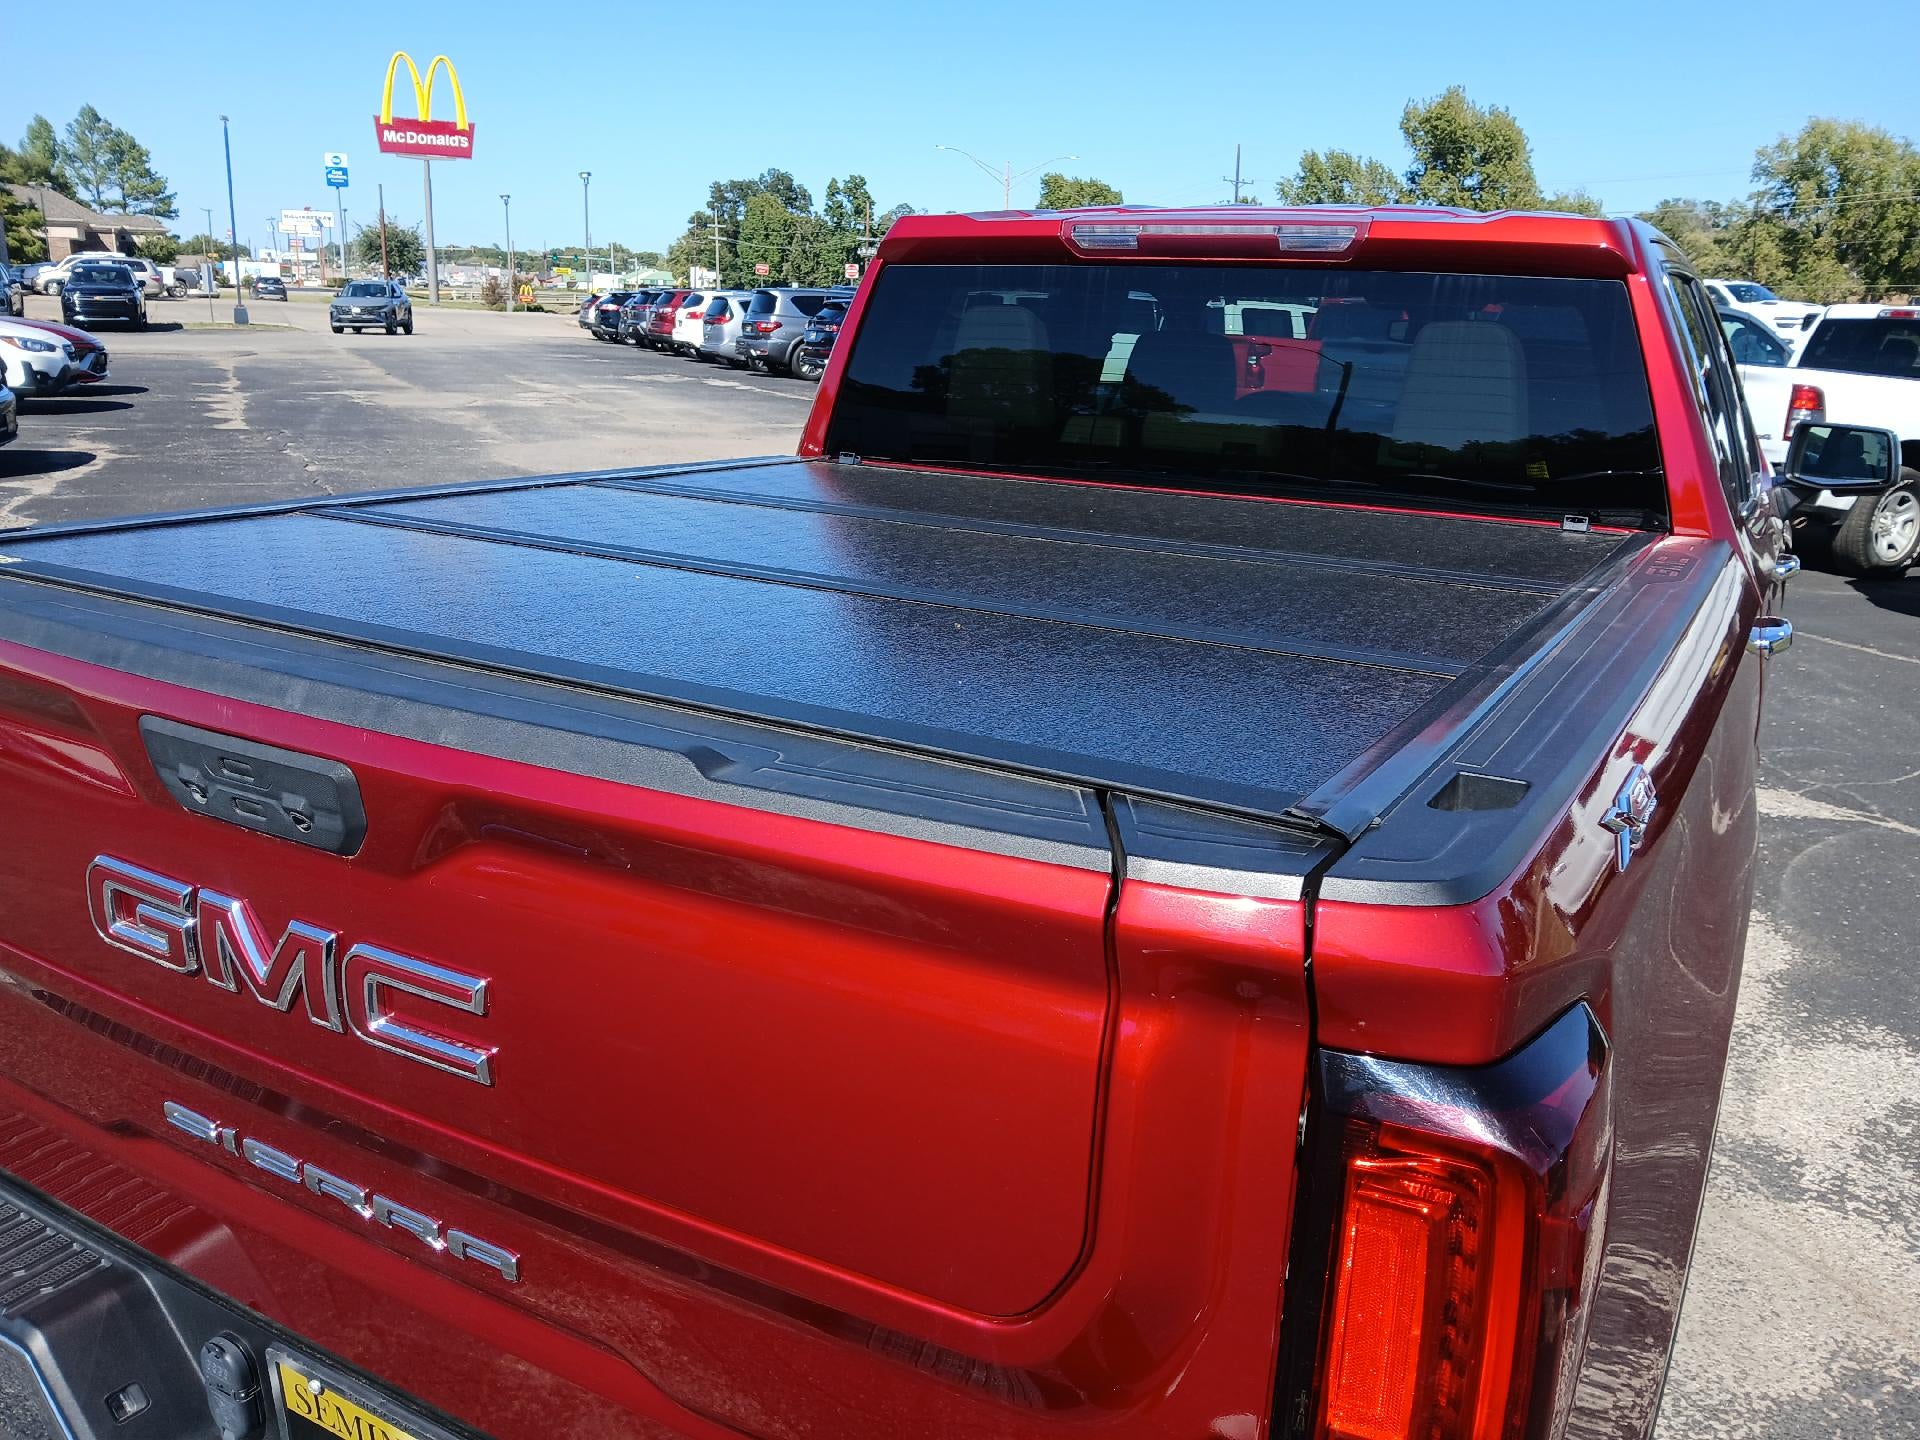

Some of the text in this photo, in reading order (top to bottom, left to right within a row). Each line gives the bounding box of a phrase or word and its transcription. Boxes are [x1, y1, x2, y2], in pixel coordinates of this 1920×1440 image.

[382, 129, 470, 148] McDonald's
[86, 853, 499, 1087] GMC
[163, 1100, 522, 1283] SIERRA
